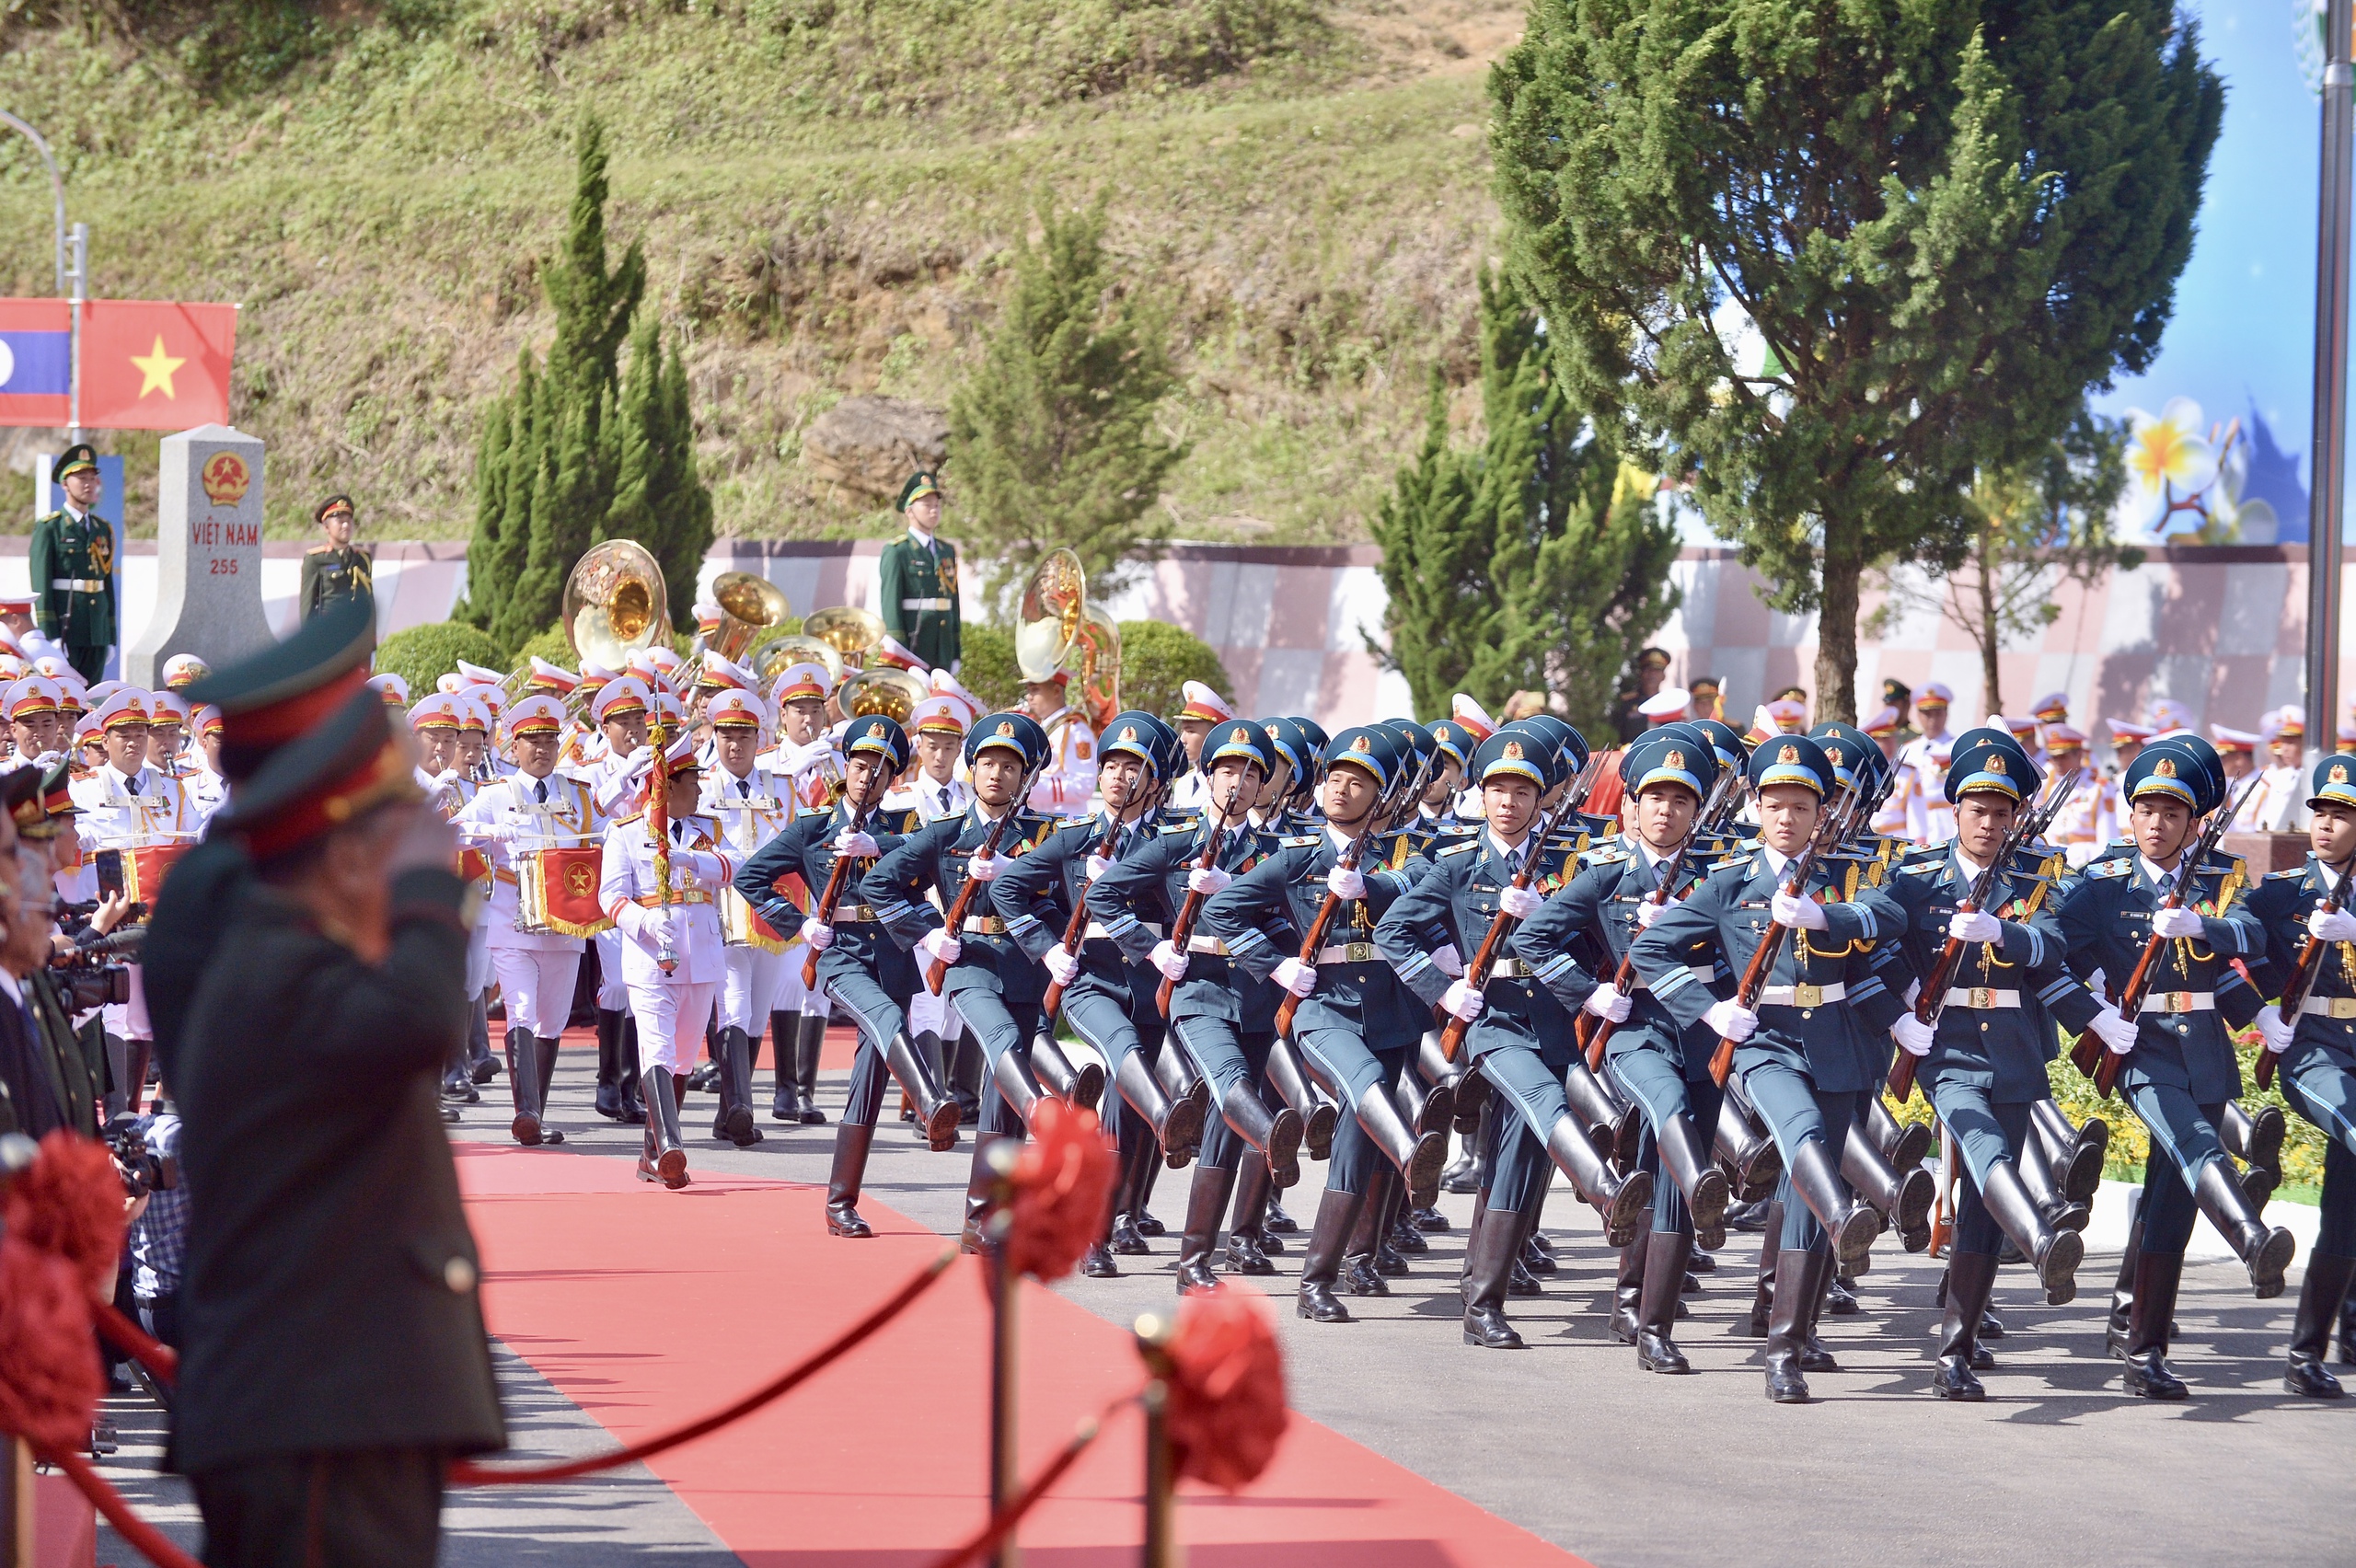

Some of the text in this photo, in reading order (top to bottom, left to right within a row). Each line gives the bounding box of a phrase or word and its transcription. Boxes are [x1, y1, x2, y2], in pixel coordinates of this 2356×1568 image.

[192, 515, 259, 552] VIỆT NAM
[210, 559, 238, 575] 255
